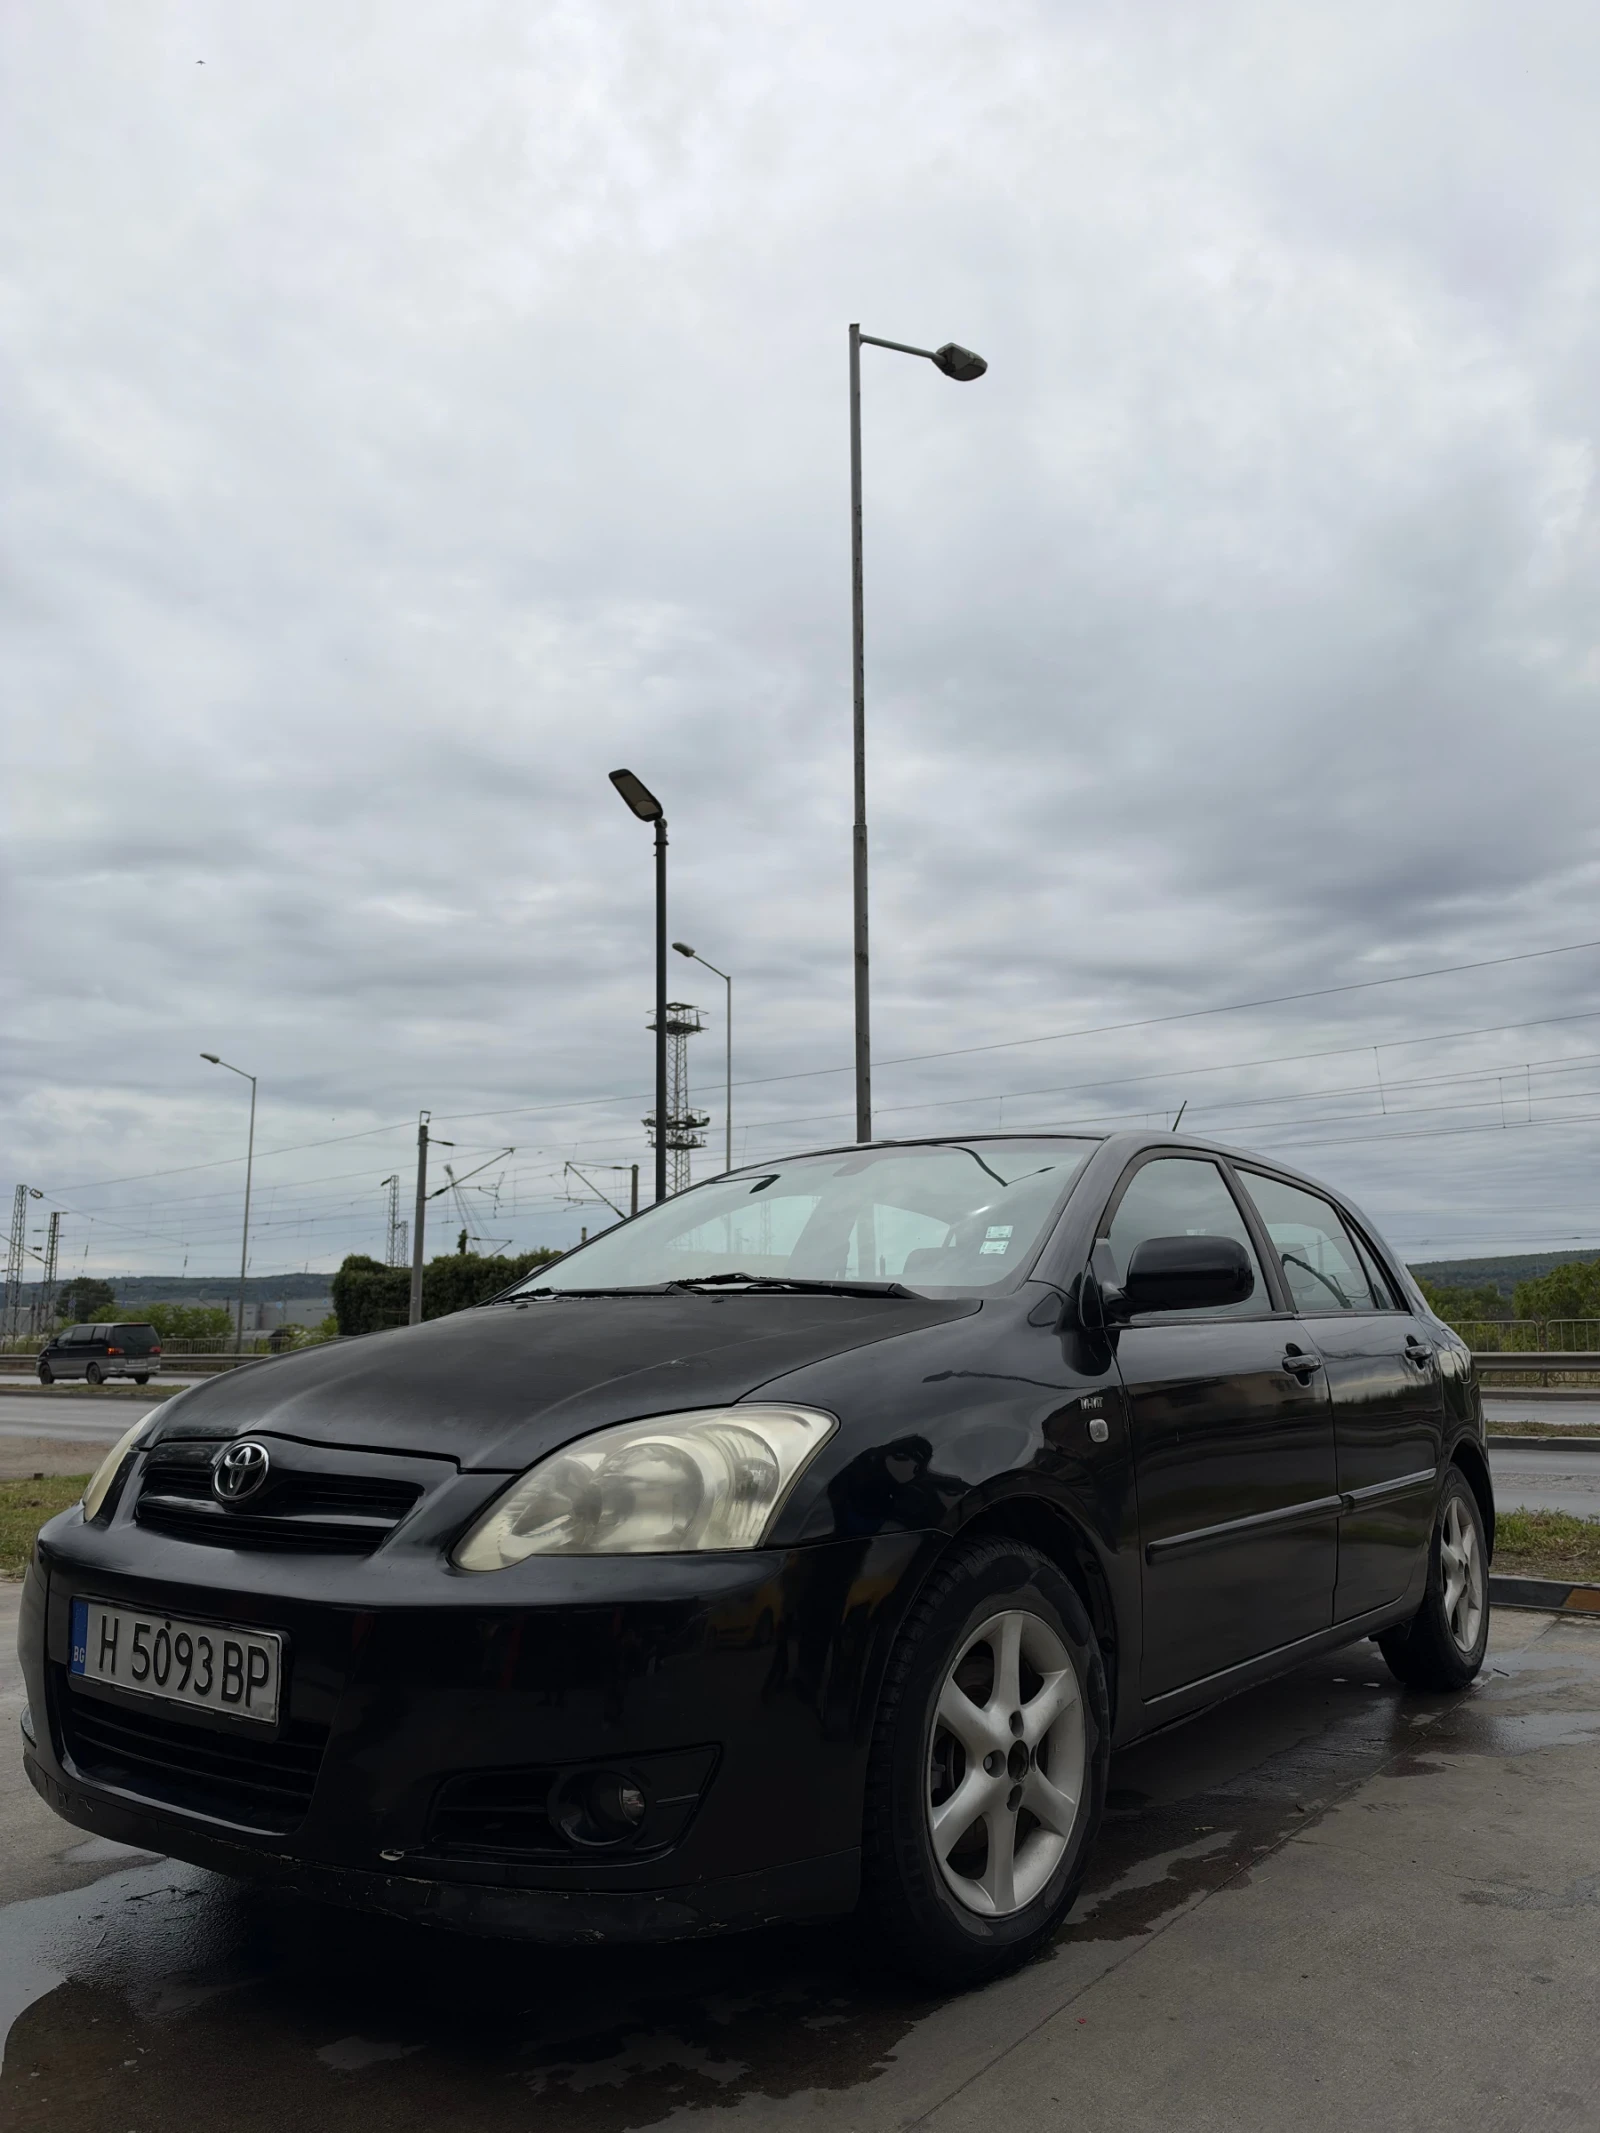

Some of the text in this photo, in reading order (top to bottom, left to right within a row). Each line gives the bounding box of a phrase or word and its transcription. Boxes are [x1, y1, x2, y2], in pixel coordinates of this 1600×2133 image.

[73, 1645, 85, 1664] BG
[98, 1614, 270, 1709] H 5093 BP
